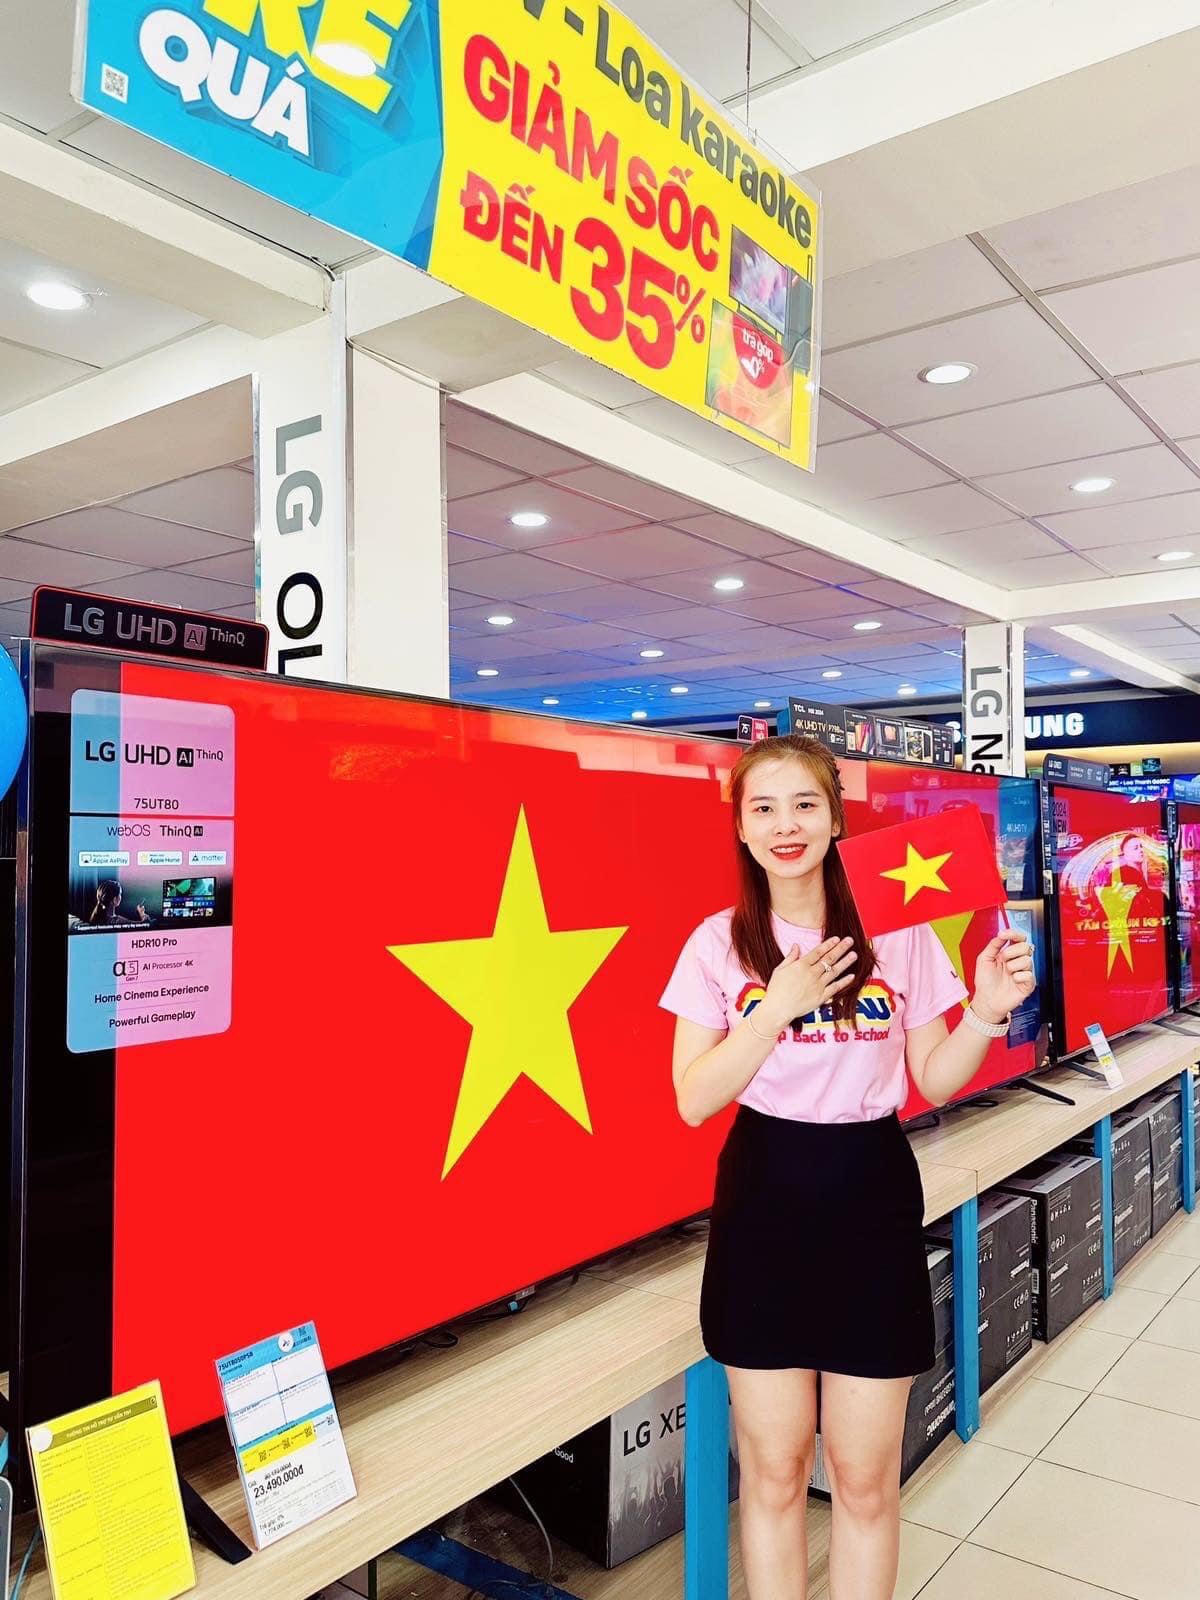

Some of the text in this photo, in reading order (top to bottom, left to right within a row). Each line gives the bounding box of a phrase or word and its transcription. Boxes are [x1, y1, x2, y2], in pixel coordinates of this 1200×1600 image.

[139, 9, 309, 156] QUÁ
[595, 4, 671, 129] Loa
[680, 80, 812, 249] karaoke
[463, 33, 720, 272] GIẢM SỐC
[460, 170, 706, 370] ĐẾN 35%
[276, 414, 323, 535] LG
[63, 603, 246, 648] LG UHD AI ThinQ
[970, 666, 1002, 718] LG
[794, 704, 806, 713] TCL
[804, 720, 817, 731] UHD
[818, 722, 826, 732] TV
[85, 740, 224, 766] LG UHD AI ThinQ
[134, 798, 179, 810] 75UT80
[107, 824, 151, 837] webOS
[159, 824, 192, 837] ThinQ
[131, 937, 178, 949] HDR10 Pro
[143, 963, 151, 971] AI
[152, 961, 183, 970] Processor
[184, 959, 194, 967] 4K
[94, 984, 210, 1004] Home Cinema Experience
[109, 1009, 196, 1028] Powerful Gameplay
[833, 1031, 849, 1043] to
[854, 1027, 890, 1042] school
[1030, 1199, 1038, 1245] Panasonic
[623, 1420, 651, 1456] LG
[554, 1447, 574, 1464] Good
[254, 1464, 304, 1499] 23,490,000đ
